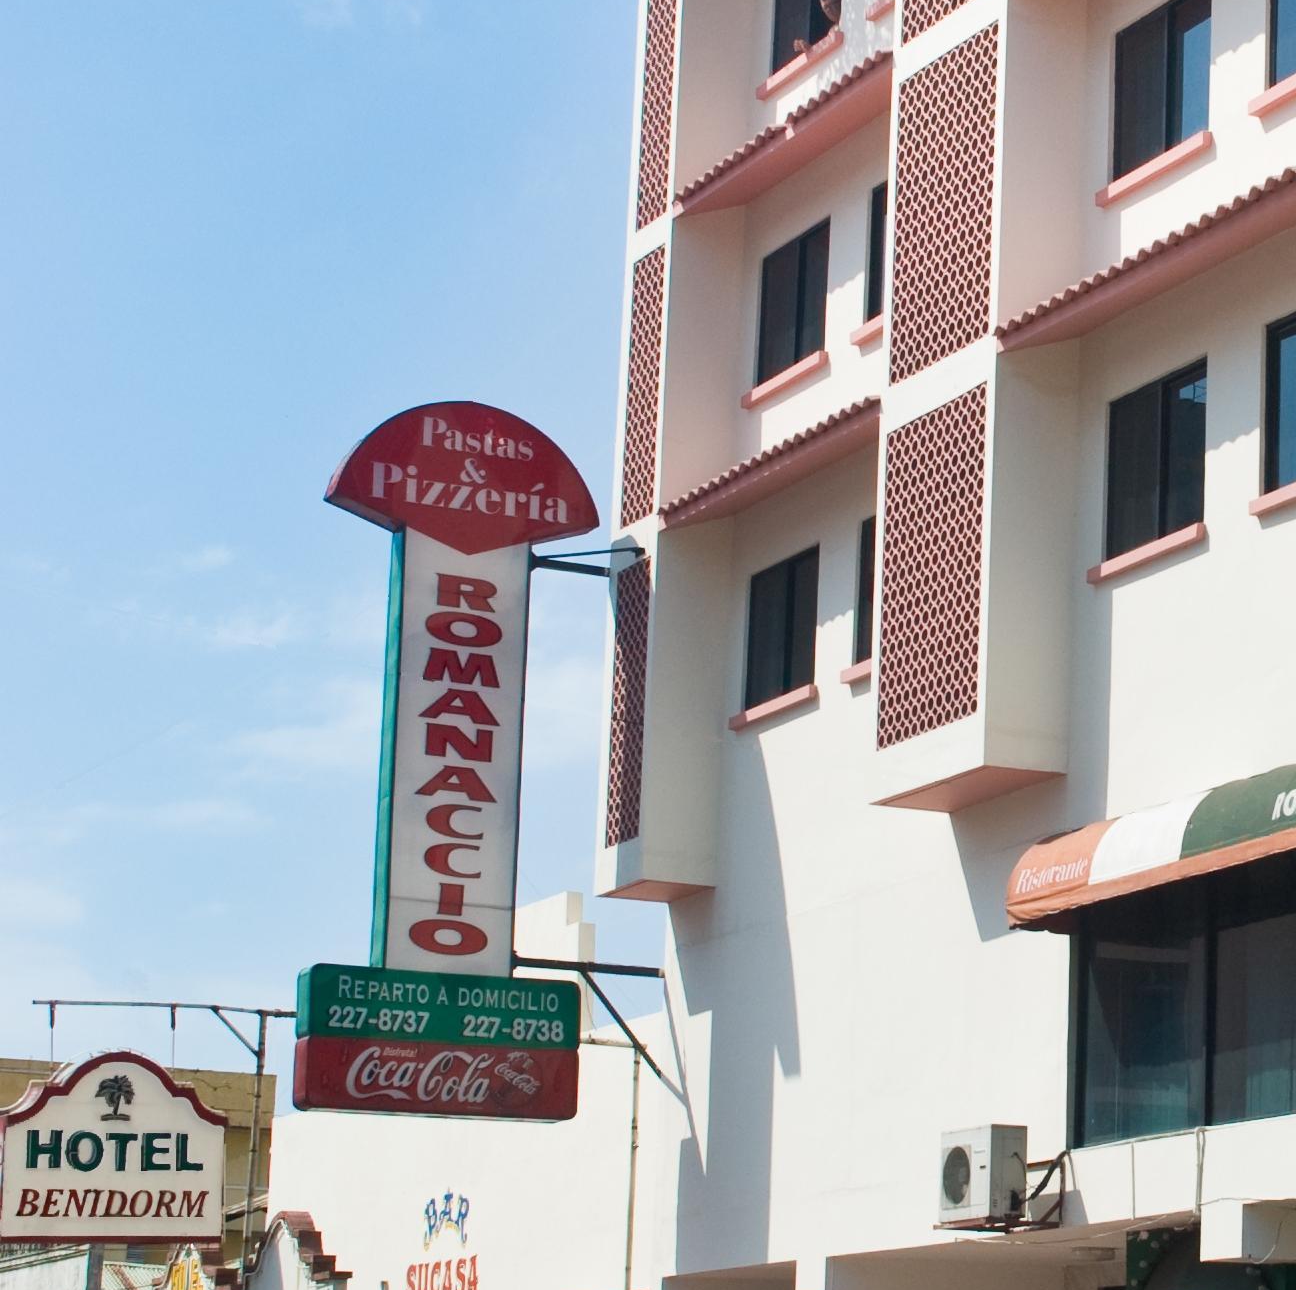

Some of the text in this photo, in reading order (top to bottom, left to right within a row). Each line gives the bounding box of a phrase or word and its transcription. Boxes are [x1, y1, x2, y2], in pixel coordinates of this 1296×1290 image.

[420, 415, 535, 461] Pastas
[370, 460, 570, 525] Pizzería
[459, 458, 487, 485] &
[408, 572, 503, 957] ROMANACCIO
[1015, 858, 1090, 894] Ristorante
[338, 974, 559, 1013] REPARTO A DOMICILIO
[328, 1005, 565, 1043] 227-8737 227-8738
[346, 1046, 496, 1104] Coca-Cola
[26, 1129, 204, 1172] HOTEL
[15, 1188, 210, 1218] BENIDORM
[424, 1188, 470, 1251] BAR
